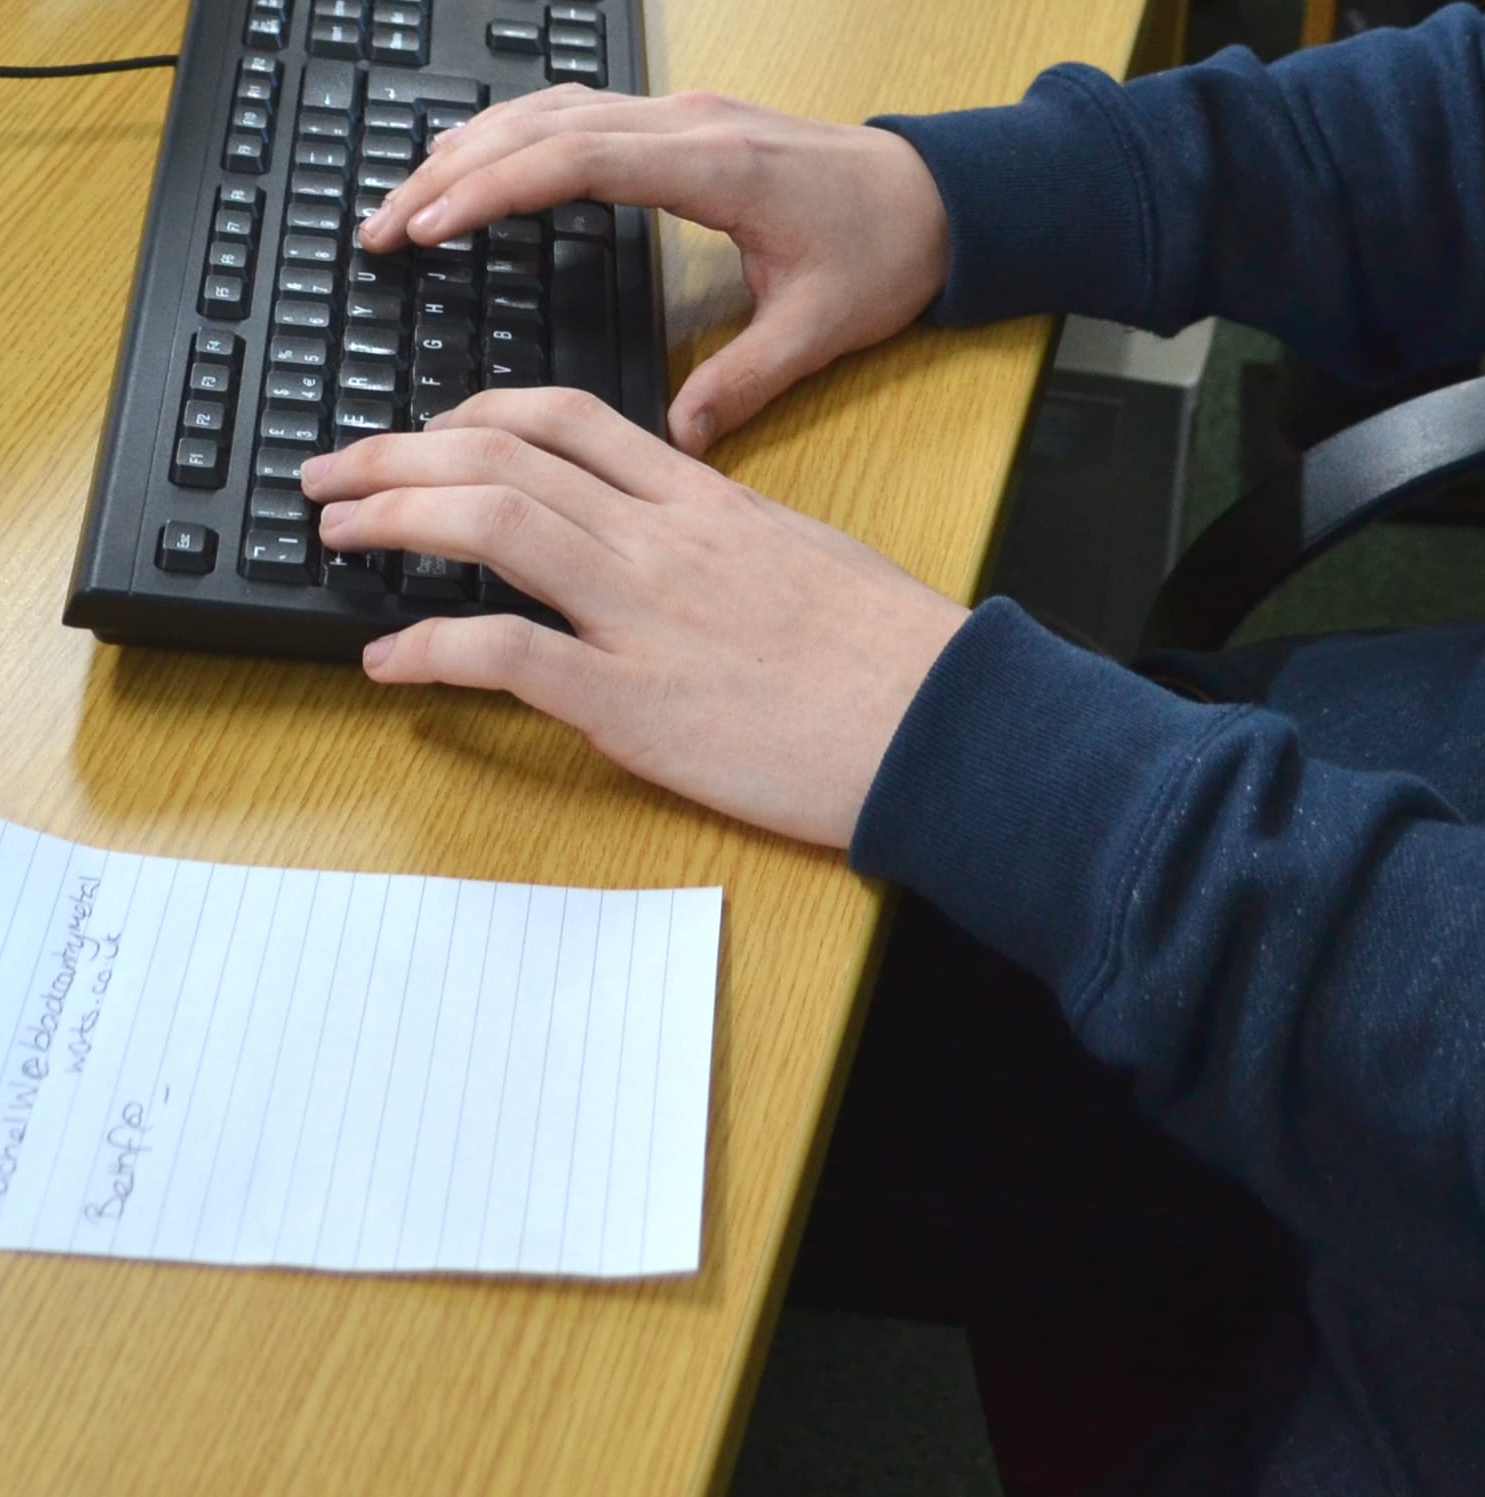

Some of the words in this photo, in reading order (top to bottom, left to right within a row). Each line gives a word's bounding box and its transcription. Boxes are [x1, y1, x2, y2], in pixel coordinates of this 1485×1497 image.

[357, 271, 376, 282] U
[427, 271, 446, 280] J
[352, 305, 372, 315] Y
[425, 303, 444, 314] H
[493, 330, 512, 340] B
[423, 339, 443, 350] G
[304, 354, 319, 363] 5
[493, 364, 512, 374] V
[201, 375, 216, 387] F3
[348, 376, 369, 387] R
[421, 376, 441, 386] F
[196, 412, 211, 425] F2
[343, 413, 364, 424] E
[189, 453, 204, 465] F1
[176, 533, 191, 549] Esc
